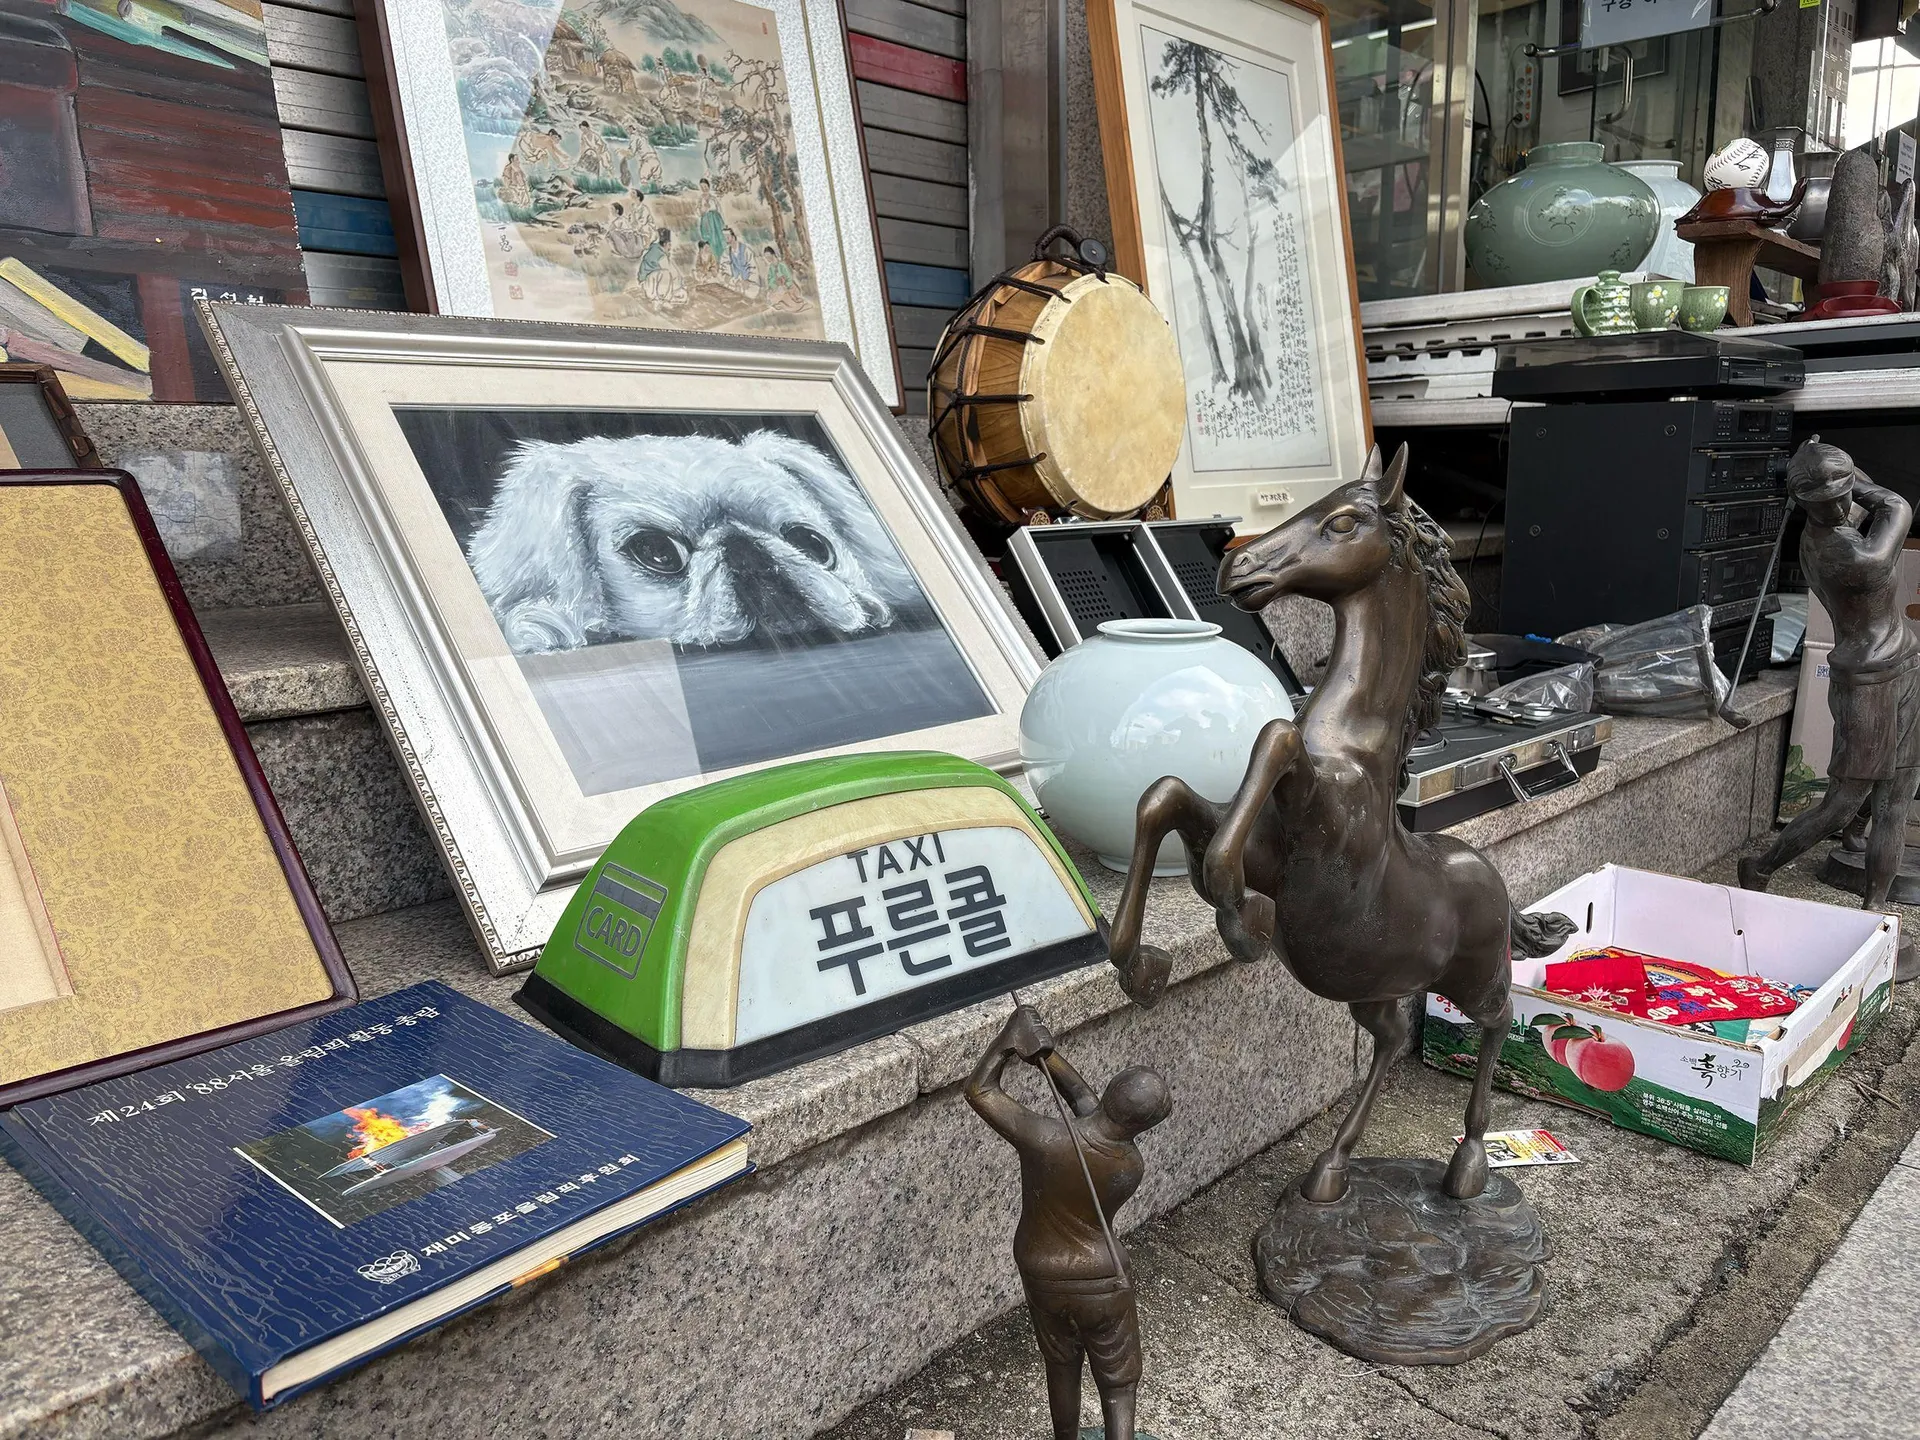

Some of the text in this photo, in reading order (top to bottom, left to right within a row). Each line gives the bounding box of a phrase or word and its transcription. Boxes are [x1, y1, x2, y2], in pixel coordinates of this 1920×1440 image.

[847, 833, 945, 883] TAXI
[586, 906, 642, 957] CARD
[809, 865, 1012, 996] 푸른콜
[277, 1038, 351, 1067] 올림픽
[394, 1006, 440, 1026] 총람
